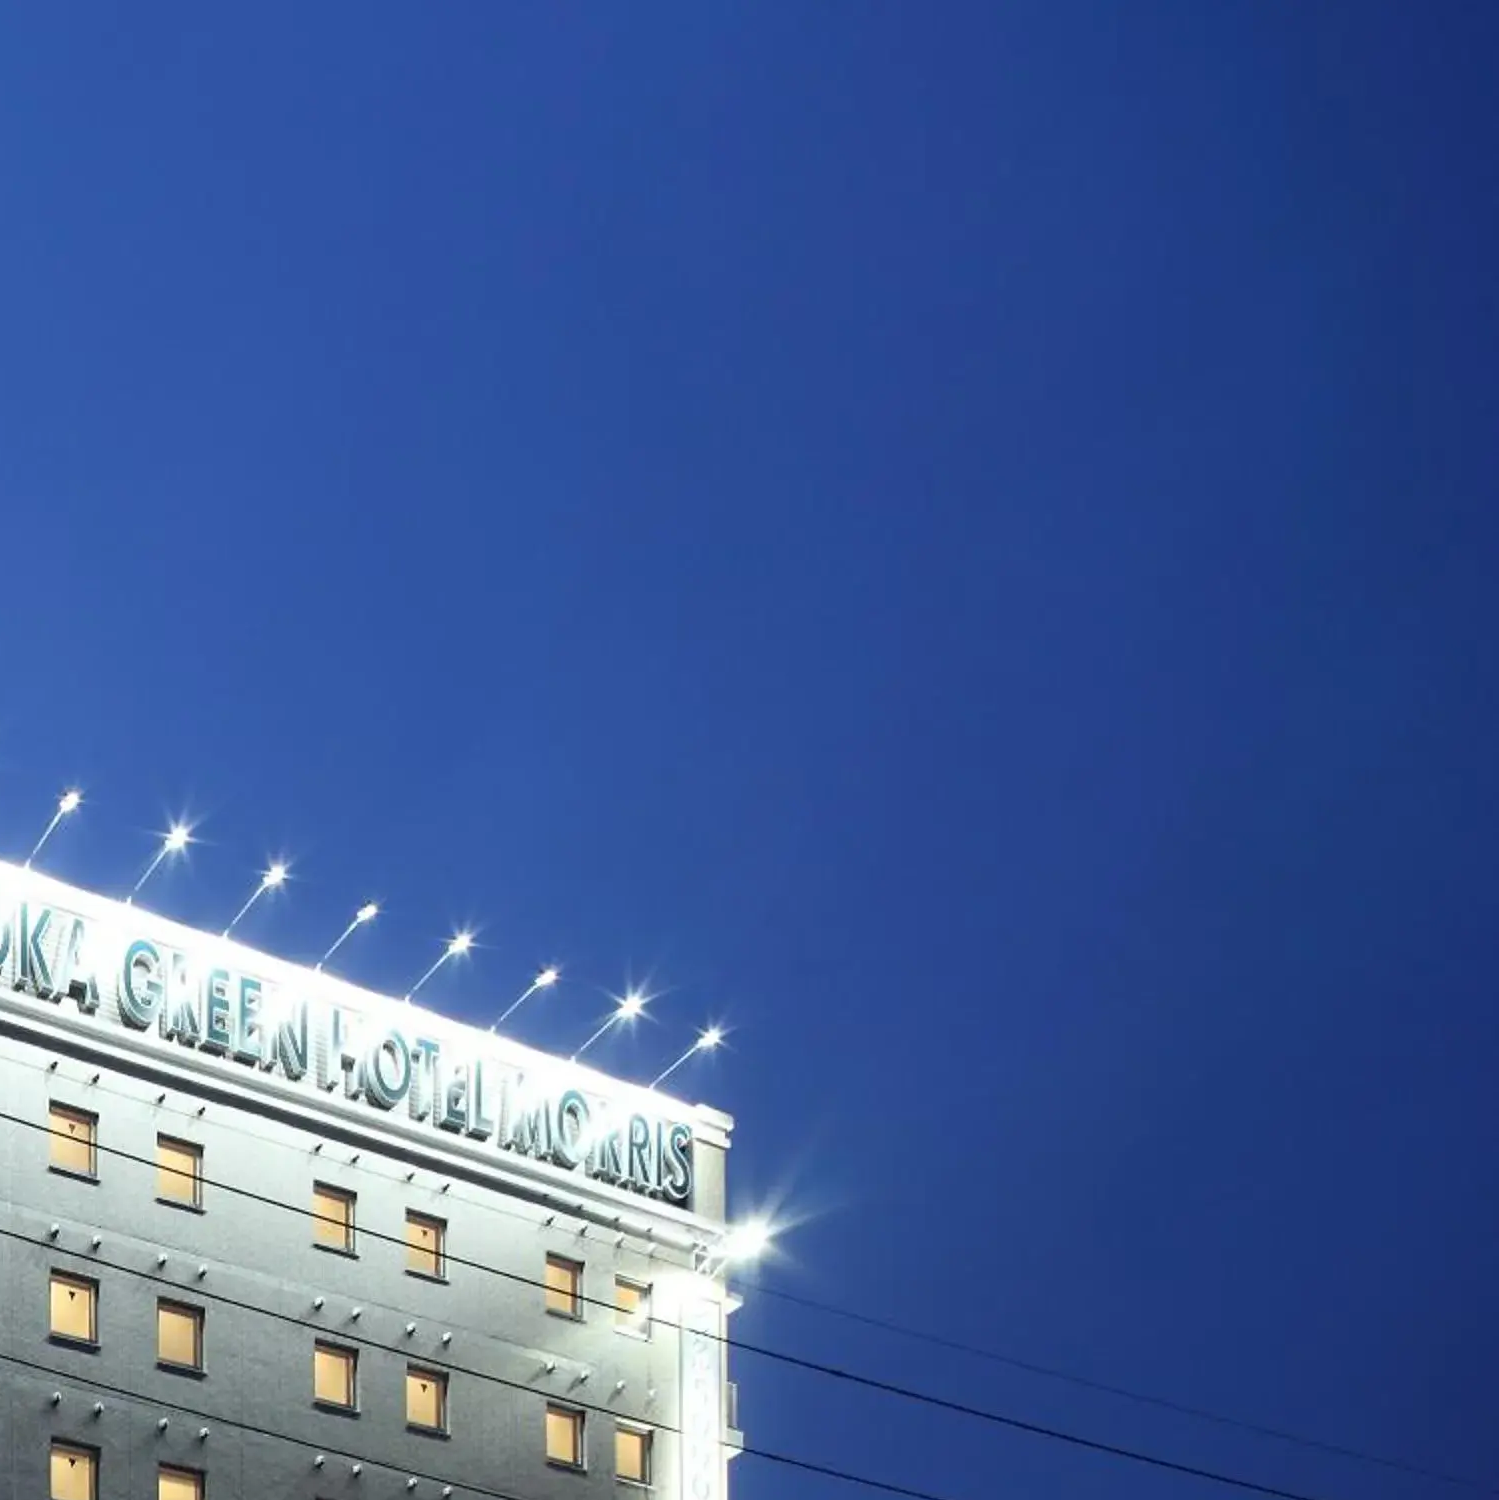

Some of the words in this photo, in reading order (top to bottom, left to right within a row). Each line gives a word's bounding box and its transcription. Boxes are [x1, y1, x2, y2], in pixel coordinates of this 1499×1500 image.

[116, 938, 308, 1082] GREEN
[316, 1003, 491, 1142] HOTEL
[498, 1064, 694, 1208] MORRIS
